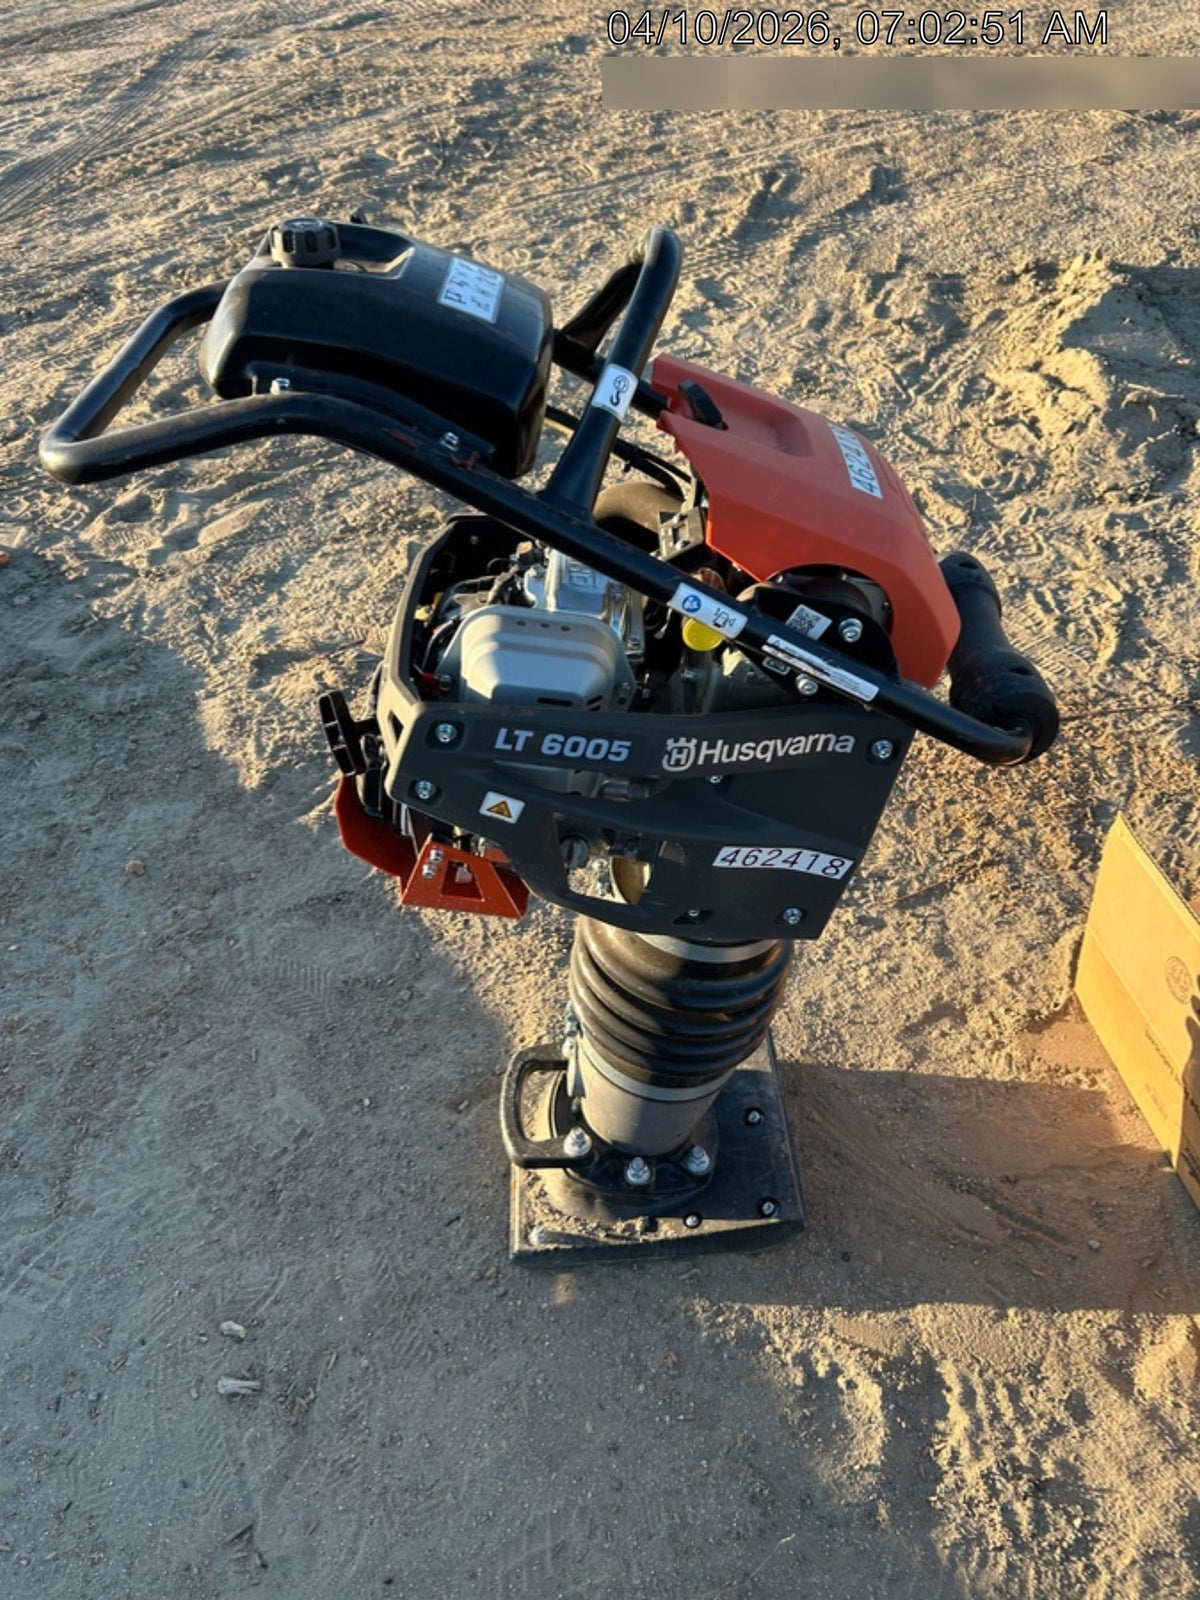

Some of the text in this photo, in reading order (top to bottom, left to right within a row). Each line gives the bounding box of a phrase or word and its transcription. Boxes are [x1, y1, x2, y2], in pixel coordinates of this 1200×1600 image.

[494, 727, 632, 762] LT 6005
[697, 733, 856, 766] Husqvarna
[720, 847, 846, 877] 462418
